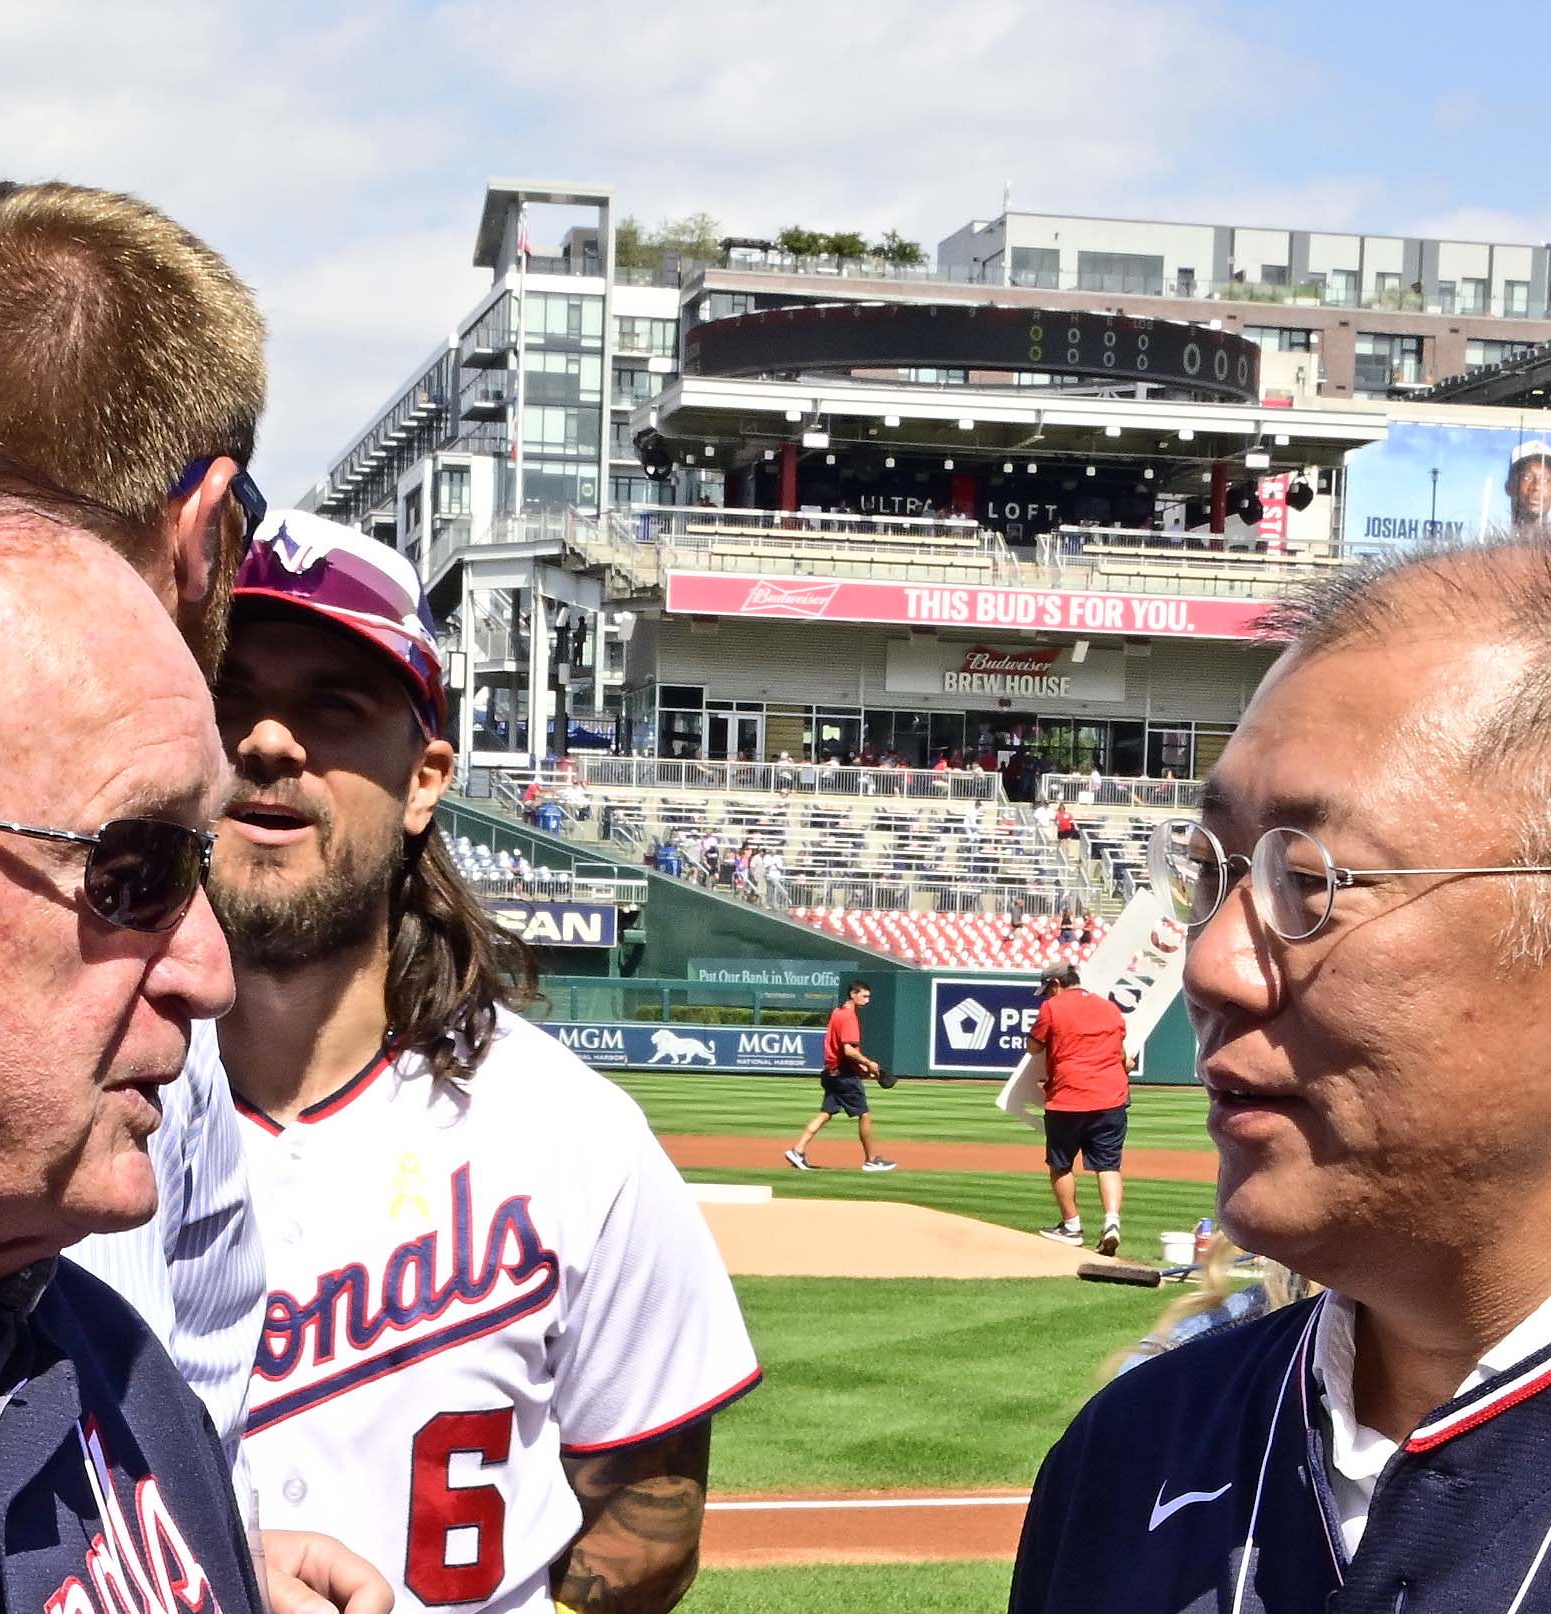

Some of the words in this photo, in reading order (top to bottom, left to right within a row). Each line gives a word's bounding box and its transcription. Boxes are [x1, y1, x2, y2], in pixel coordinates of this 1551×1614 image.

[987, 501, 1058, 521] LOFT
[1364, 516, 1419, 539] JOSIAH
[753, 588, 832, 607] Budweiser
[904, 588, 974, 622] THIS
[981, 591, 1062, 626] BUD'S
[1068, 595, 1122, 628] FOR
[1133, 598, 1196, 631] YOU.
[966, 650, 1052, 673] Budweiser
[944, 670, 1001, 694] BREW
[1005, 673, 1070, 697] HOUSE
[699, 969, 717, 983] Put
[718, 970, 740, 984] Our
[742, 970, 769, 985] Bank
[771, 970, 783, 985] in
[783, 971, 810, 986] Your
[811, 971, 840, 987] Offic
[559, 1028, 625, 1050] MGM
[738, 1033, 804, 1055] MGM
[250, 1160, 561, 1384] onals
[404, 1404, 516, 1608] 6
